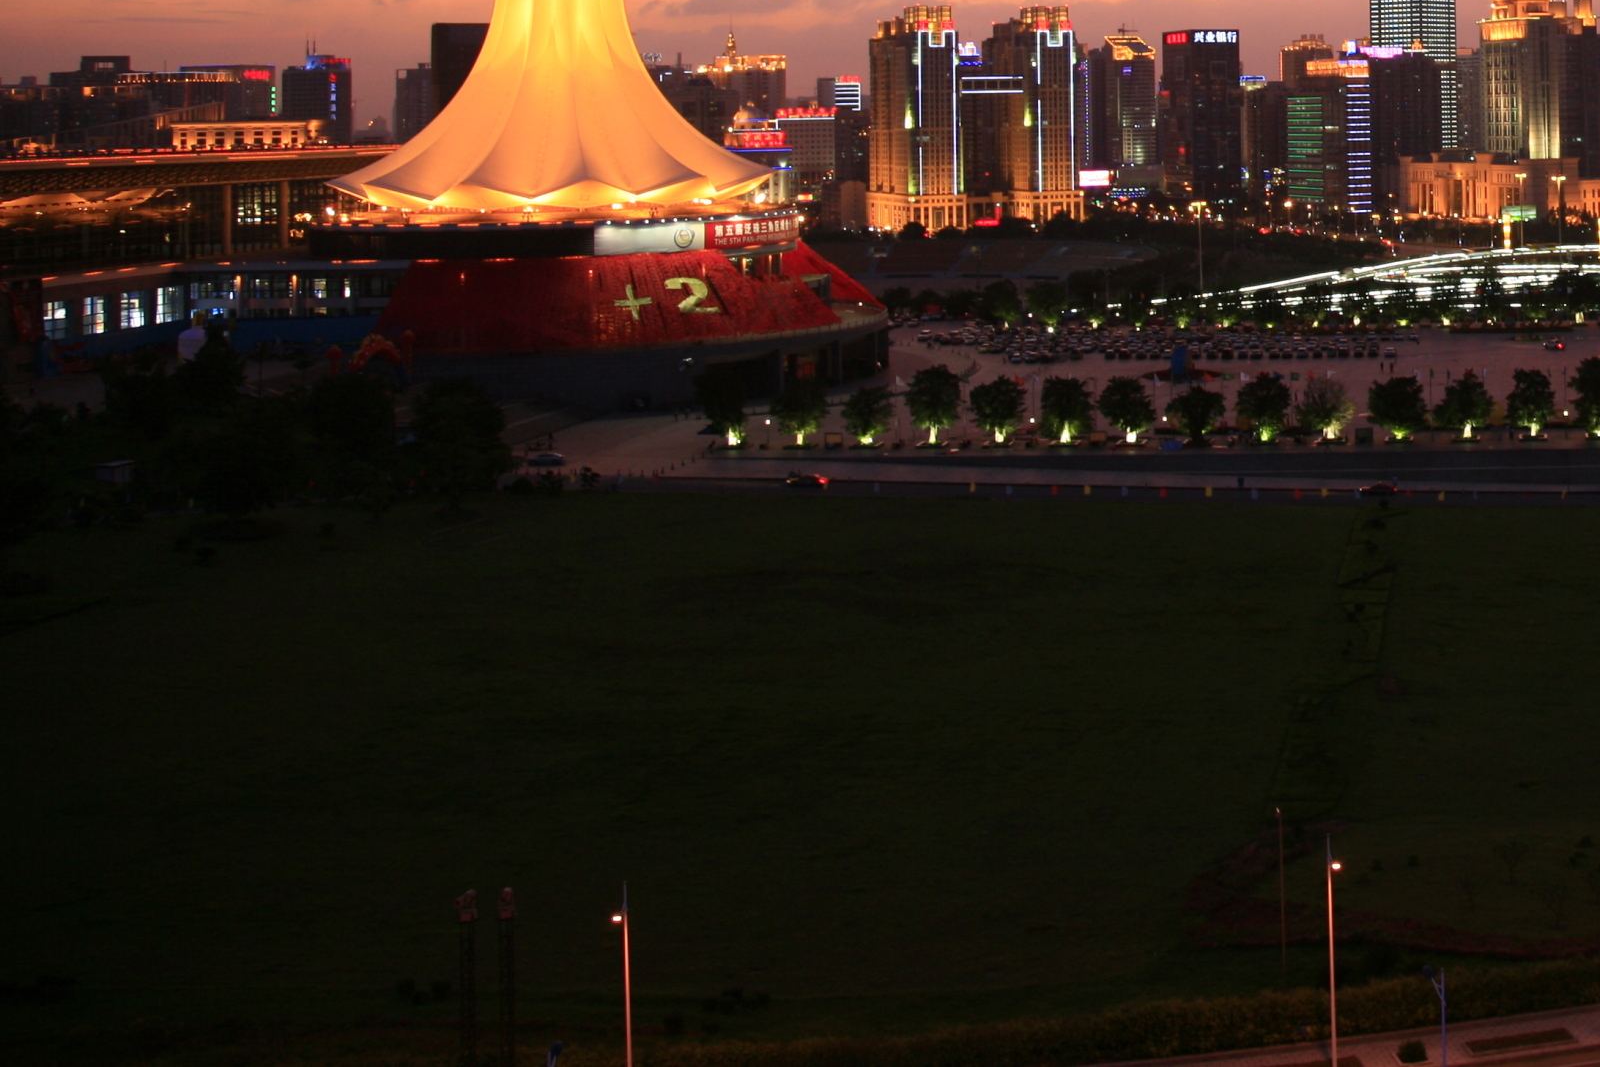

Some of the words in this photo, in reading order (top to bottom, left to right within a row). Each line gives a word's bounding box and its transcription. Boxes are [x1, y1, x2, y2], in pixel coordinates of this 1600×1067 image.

[1193, 30, 1237, 43] 兴业银行
[729, 236, 742, 244] 5TH
